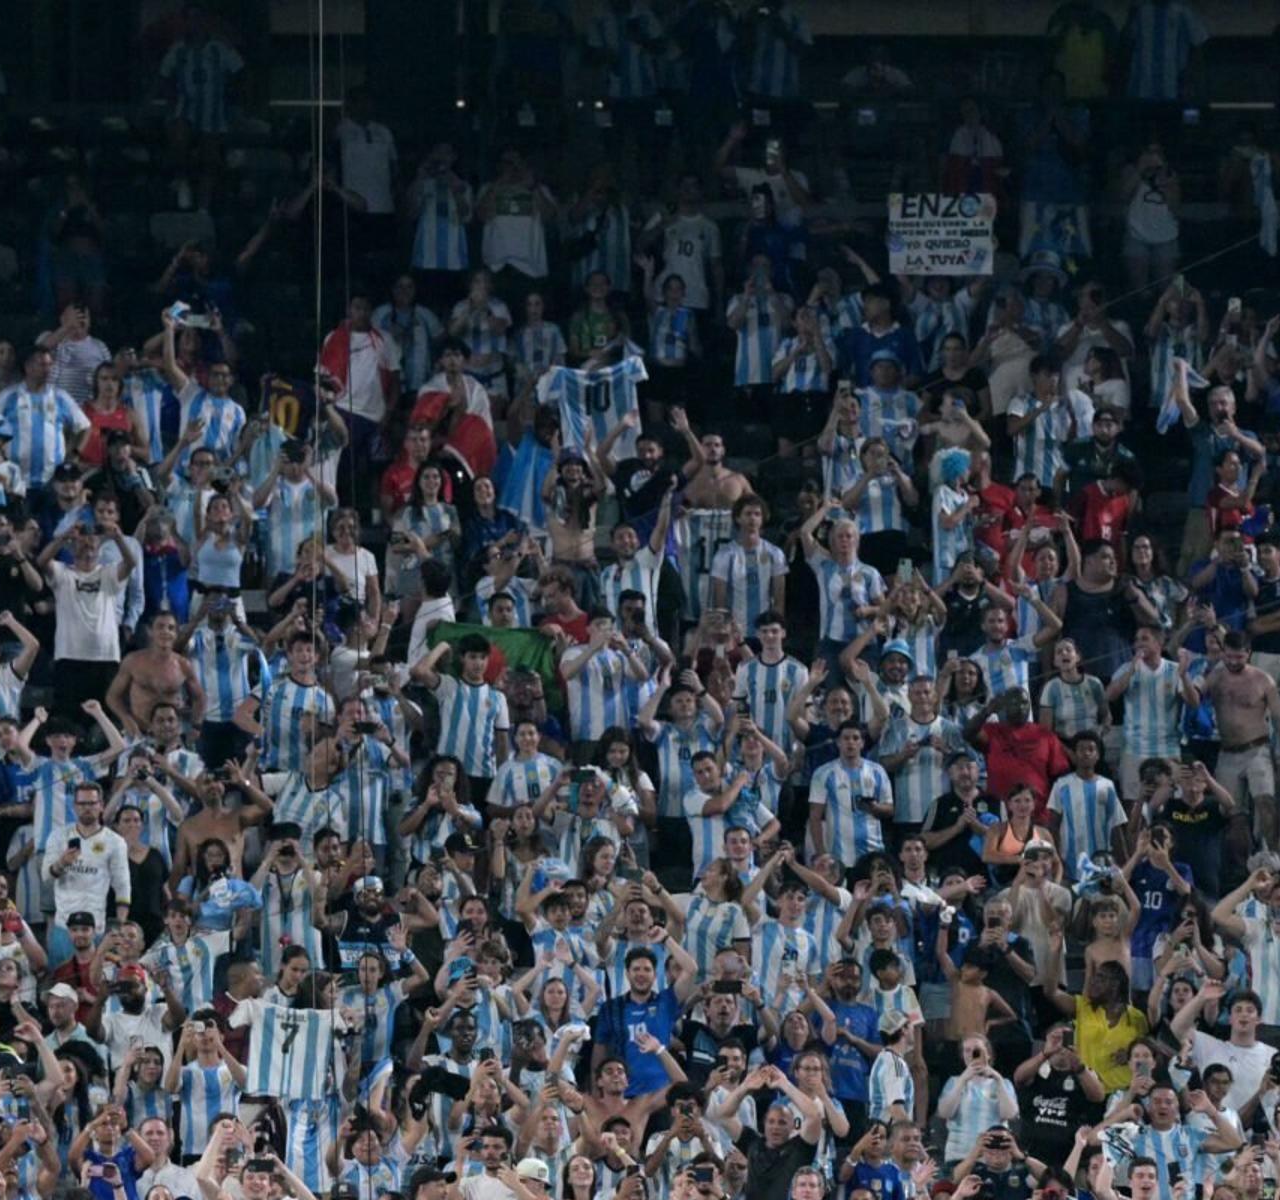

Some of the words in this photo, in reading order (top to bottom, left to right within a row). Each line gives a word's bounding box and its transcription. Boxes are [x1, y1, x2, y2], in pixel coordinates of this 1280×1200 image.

[900, 193, 981, 218] ENZO
[678, 241, 693, 257] 10
[585, 381, 608, 415] 10
[270, 395, 300, 435] 10
[1146, 889, 1163, 909] 10
[280, 1022, 300, 1054] 7
